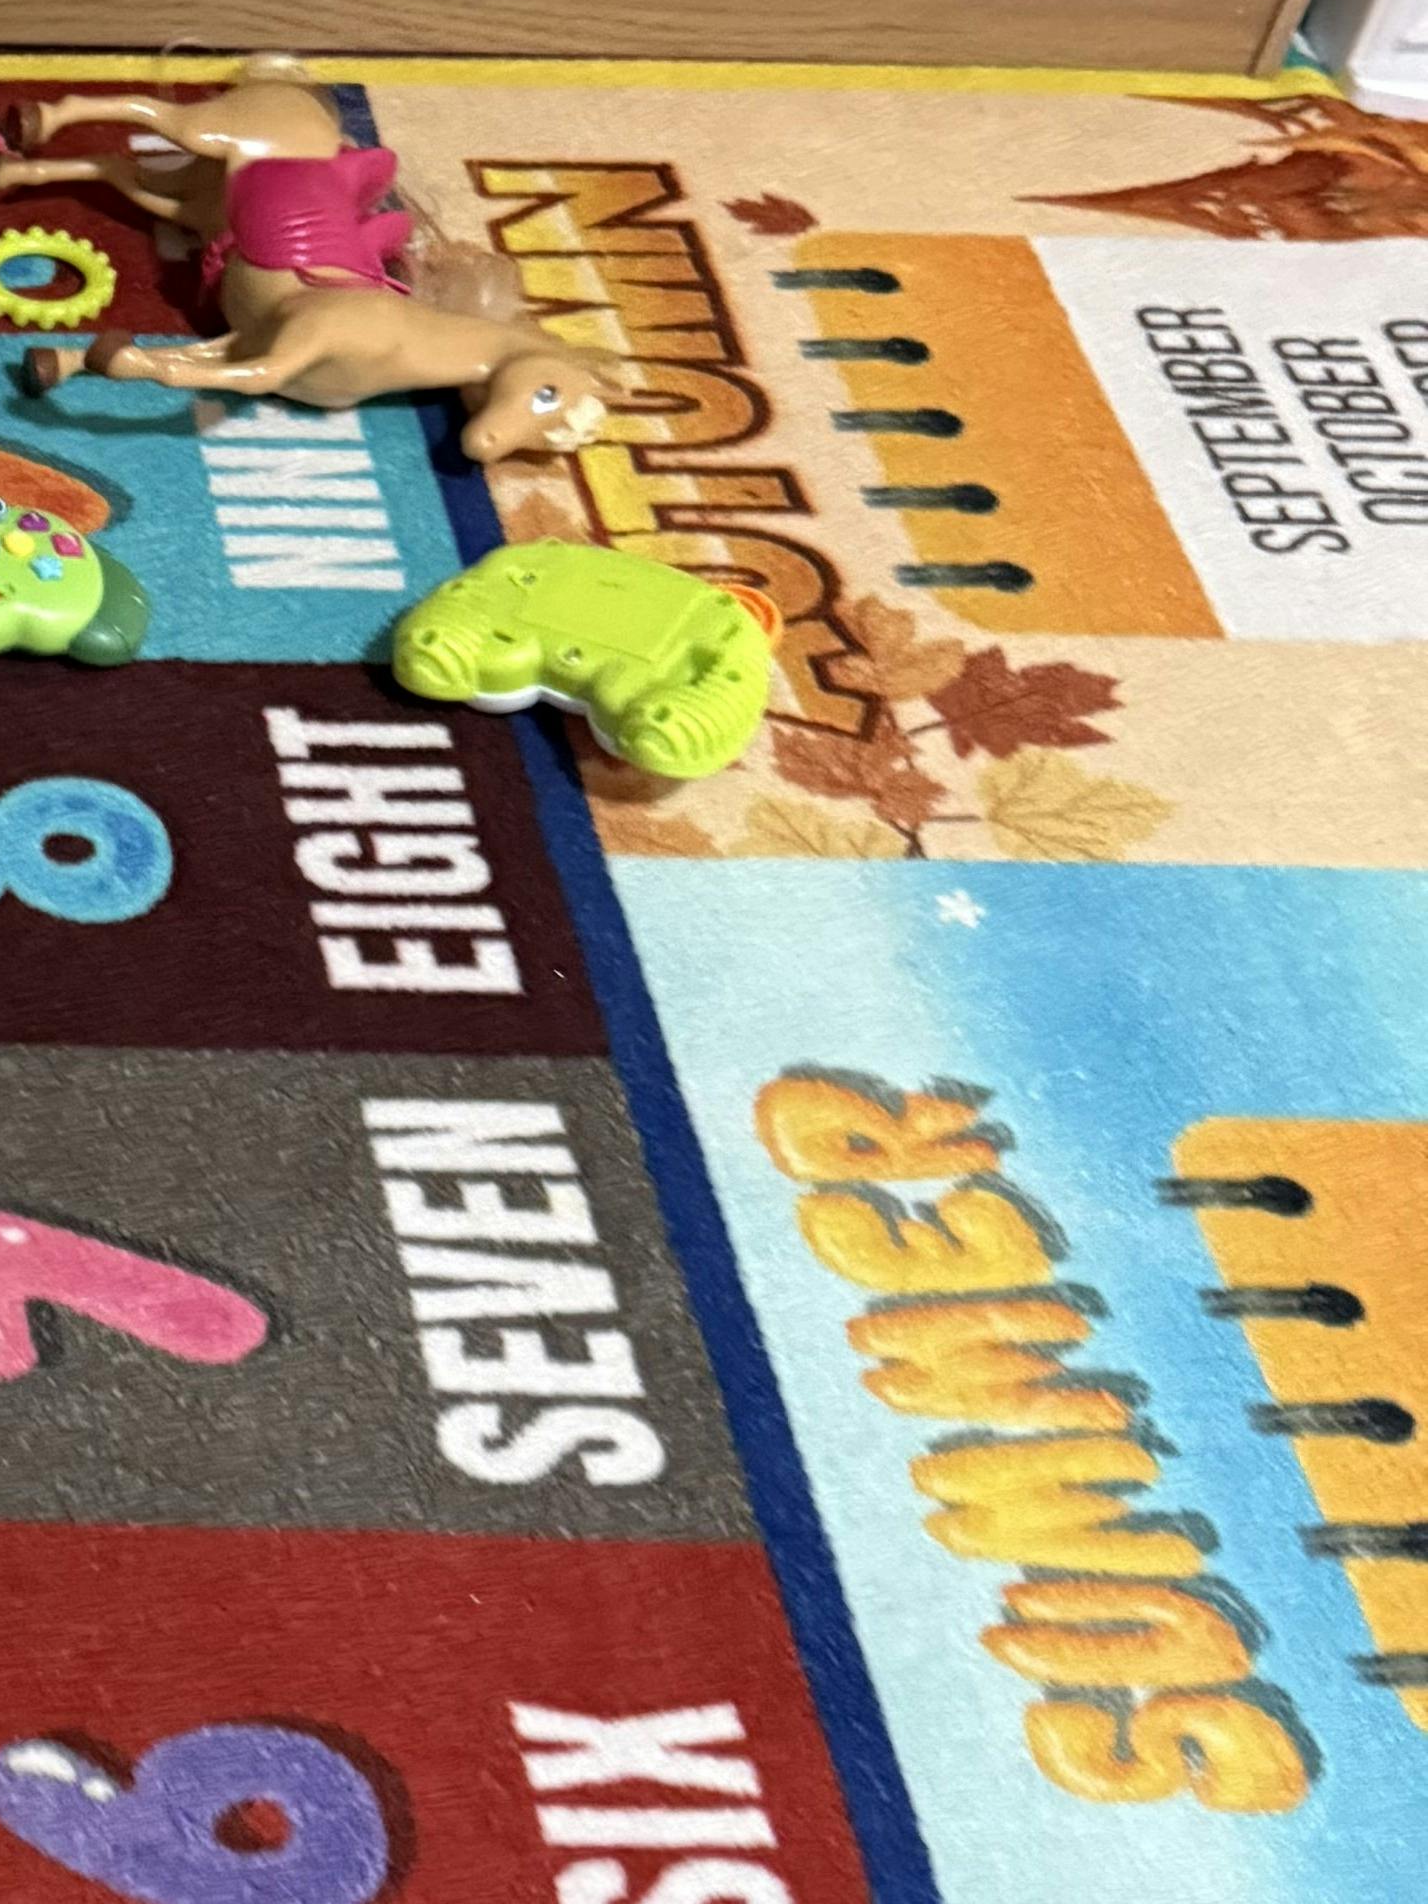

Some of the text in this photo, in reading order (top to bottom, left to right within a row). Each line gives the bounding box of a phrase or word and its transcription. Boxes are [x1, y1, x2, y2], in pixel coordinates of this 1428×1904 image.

[1134, 305, 1352, 556] SEPTEMBER
[1271, 334, 1428, 527] OCTOBER
[261, 703, 529, 996] EIGHT
[361, 1094, 670, 1489] SEVEN
[755, 1063, 1325, 1815] SUMMER
